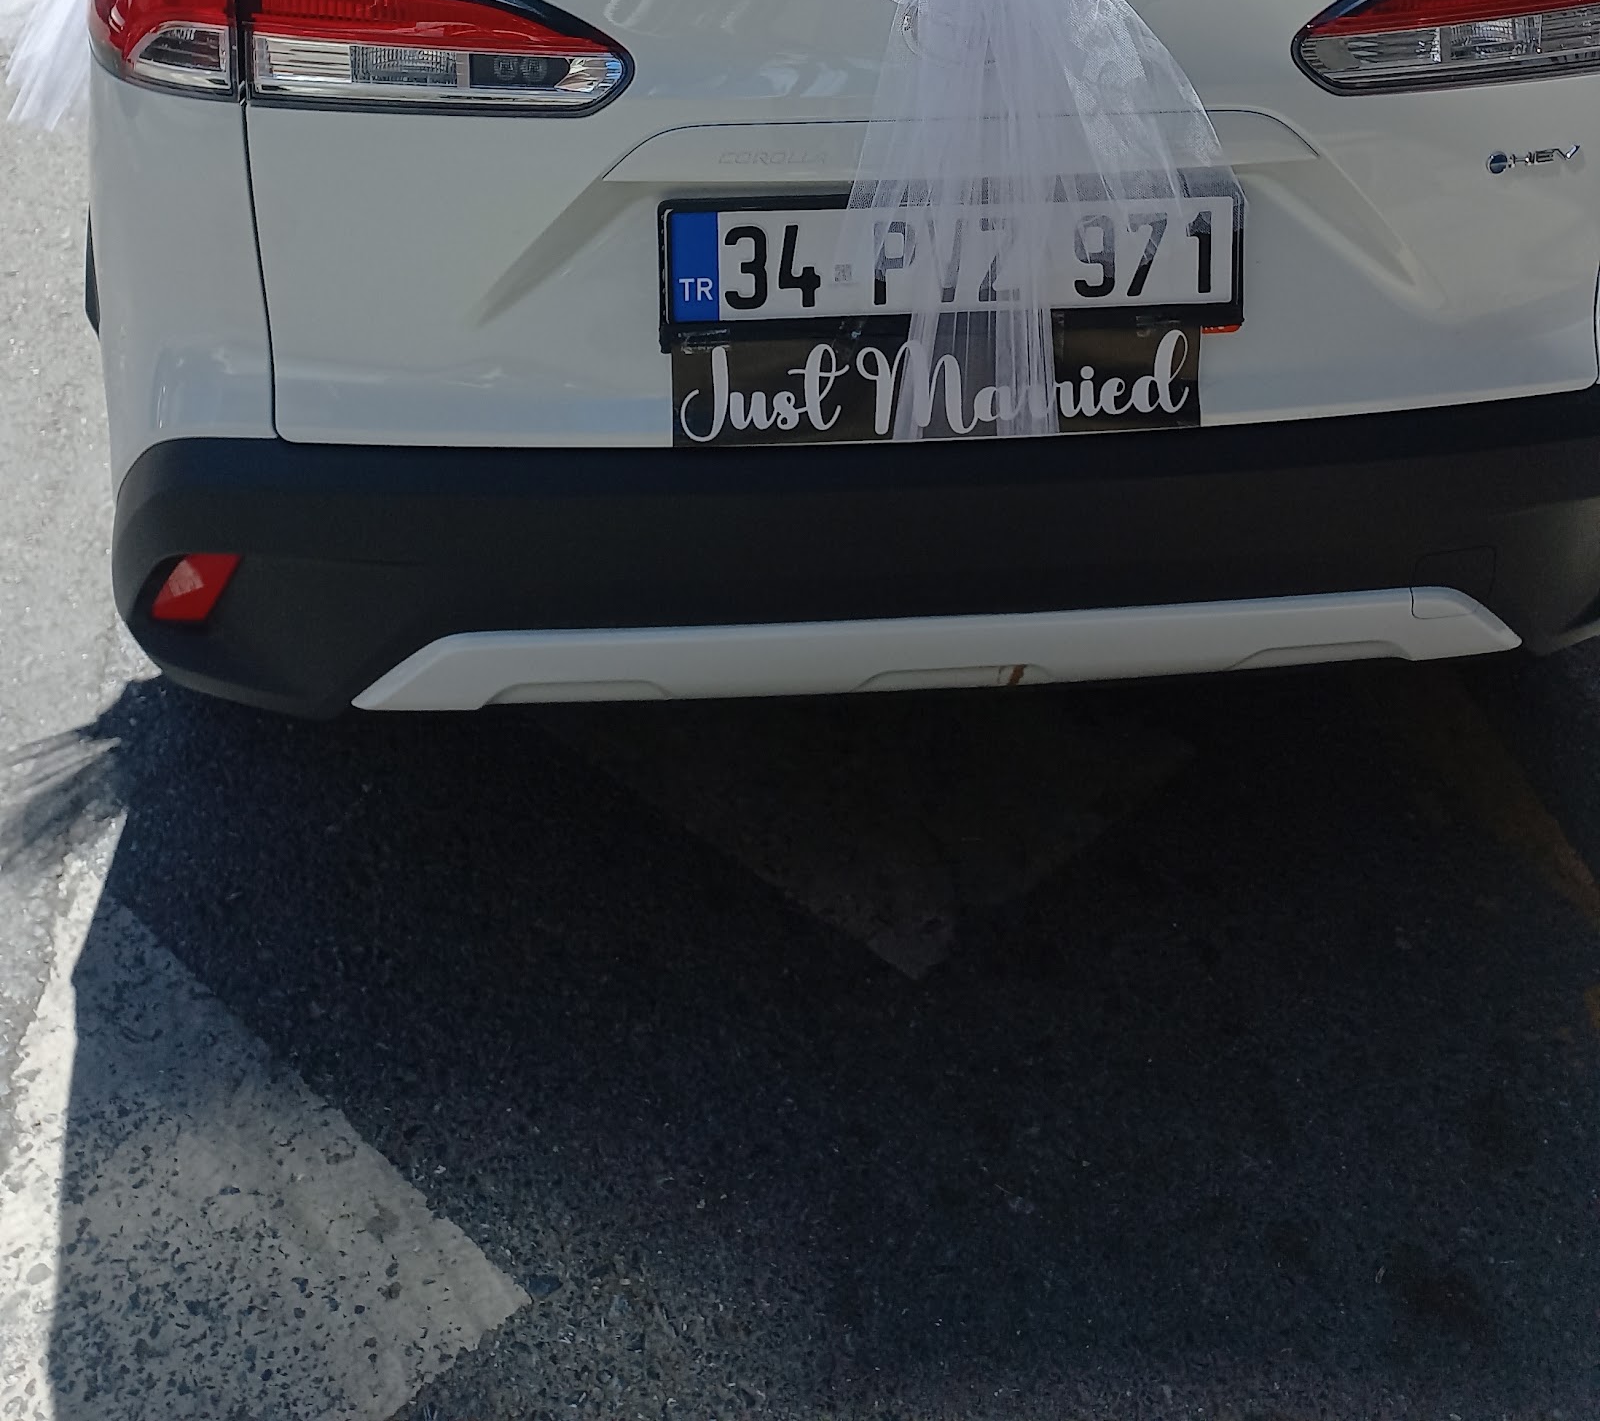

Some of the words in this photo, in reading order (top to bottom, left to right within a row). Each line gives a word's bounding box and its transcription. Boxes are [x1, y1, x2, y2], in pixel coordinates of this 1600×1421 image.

[678, 277, 714, 302] TR
[724, 223, 821, 310] 34
[1073, 210, 1212, 298] 971
[680, 343, 850, 442] Just
[855, 329, 1189, 435] Married
